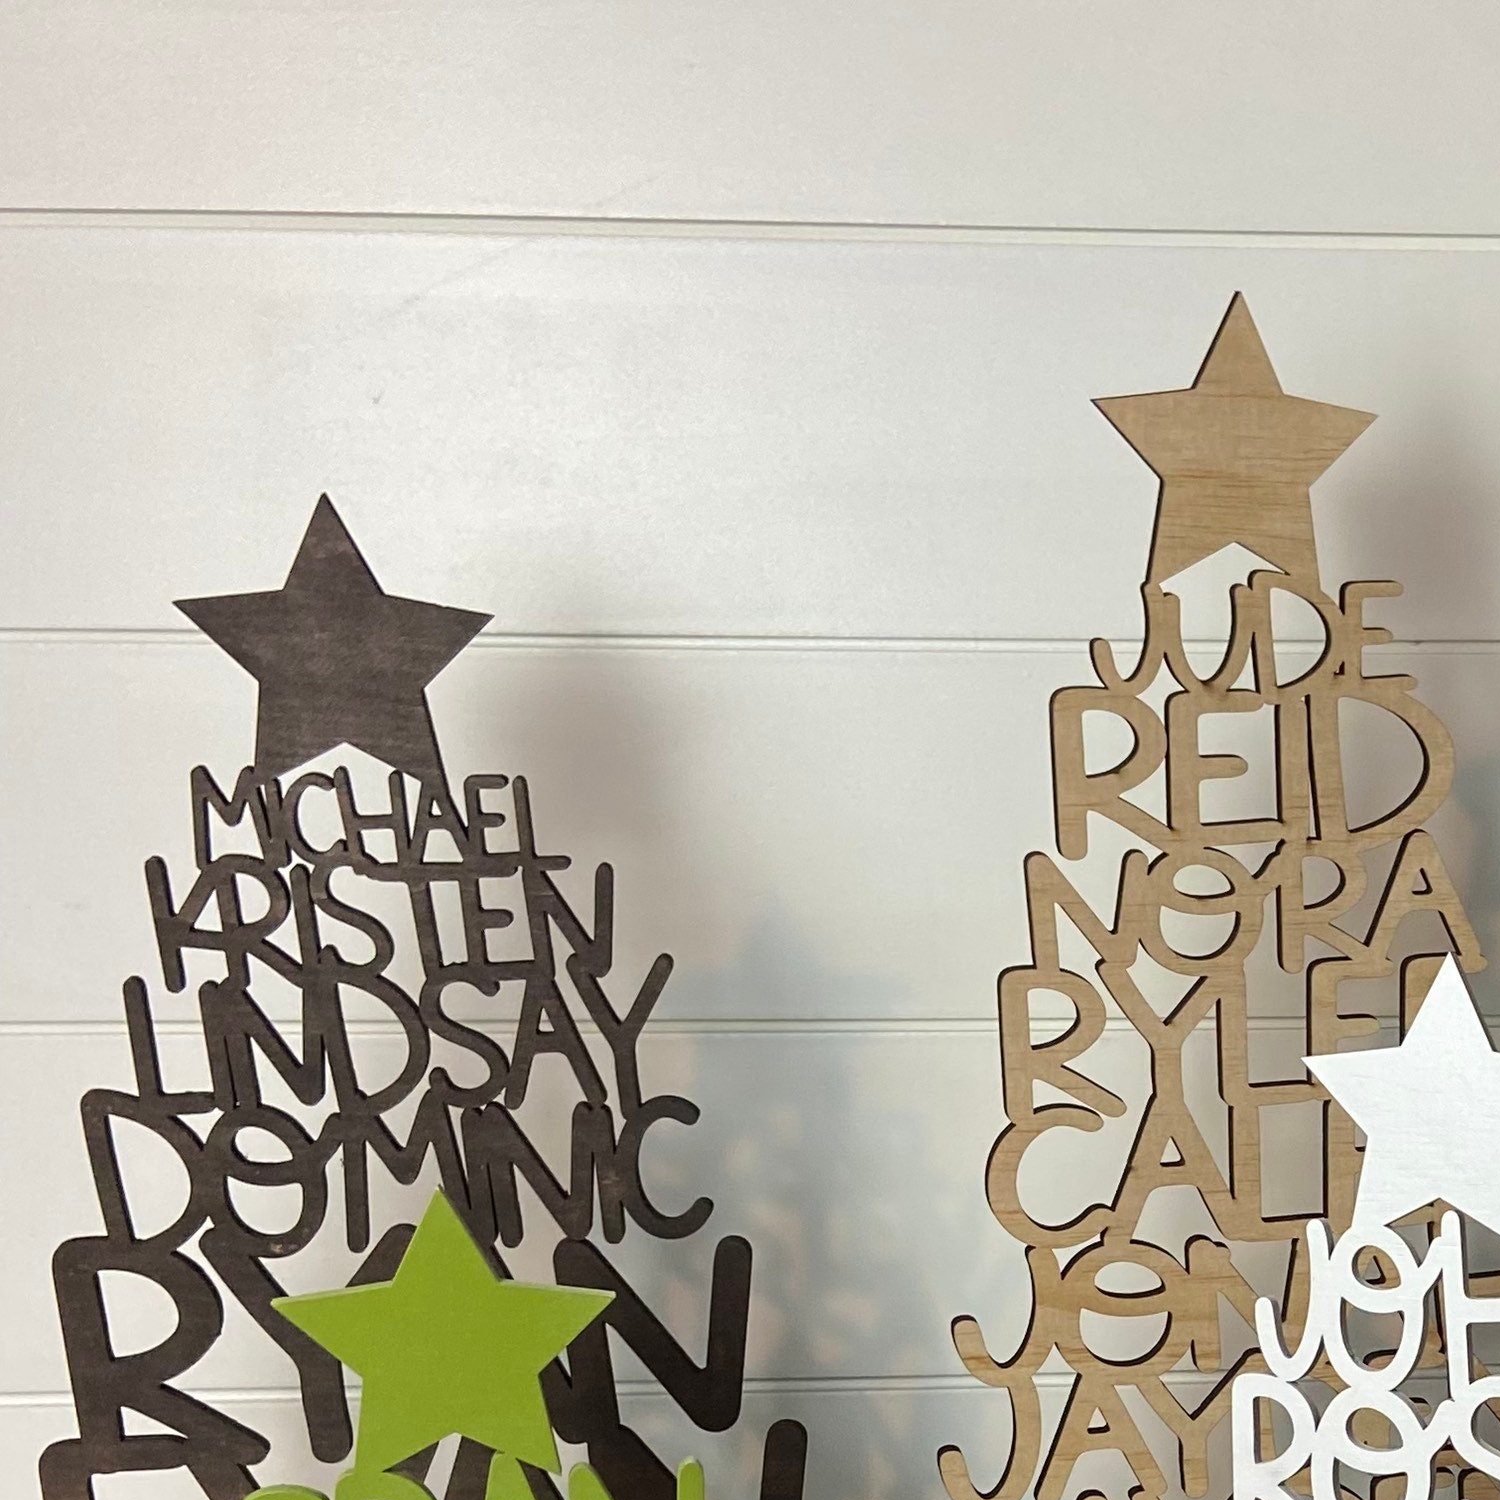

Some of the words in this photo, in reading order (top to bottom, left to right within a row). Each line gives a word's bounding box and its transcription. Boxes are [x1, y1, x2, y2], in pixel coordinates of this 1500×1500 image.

[1090, 571, 1418, 702] JUDE
[190, 765, 571, 874] MICHAEL
[1050, 686, 1456, 860] REID
[144, 850, 614, 992] KRISTEN
[1023, 829, 1488, 977] NORA
[123, 950, 674, 1115] LINDSAY
[997, 952, 1485, 1118] RYLE
[81, 1089, 715, 1258] DOMINIC
[52, 1226, 753, 1465] RYN
